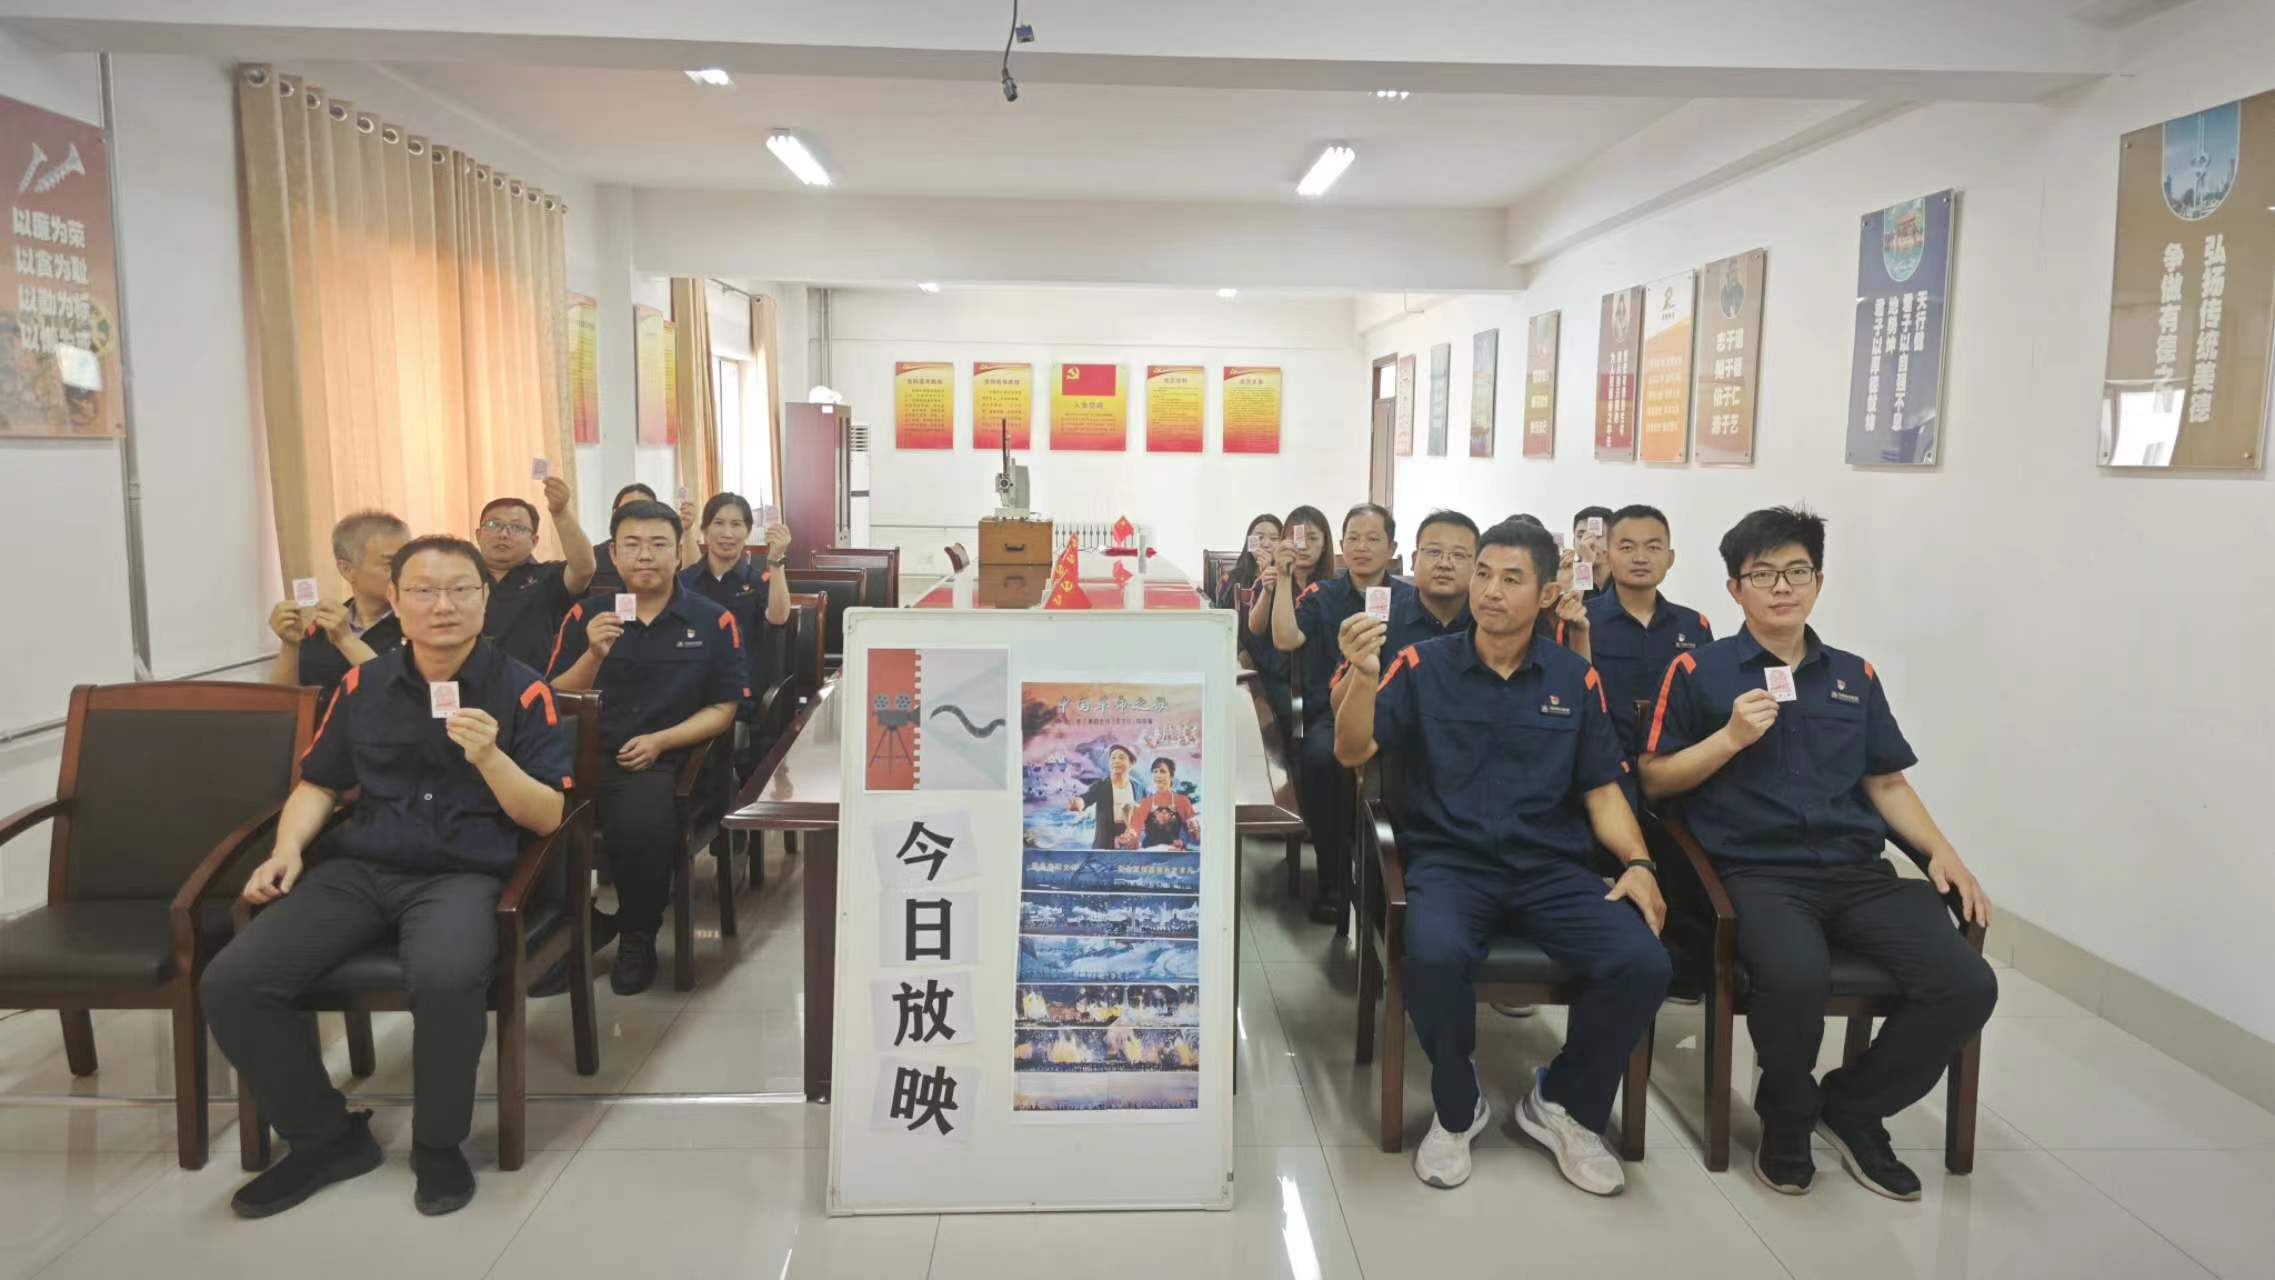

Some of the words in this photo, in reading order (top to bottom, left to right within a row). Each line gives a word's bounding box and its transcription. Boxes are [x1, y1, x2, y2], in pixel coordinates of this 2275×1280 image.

[2188, 234, 2226, 423] 弘扬传统美德
[1057, 695, 1170, 713] 中国革命之歌
[890, 821, 958, 1135] 今日放映
